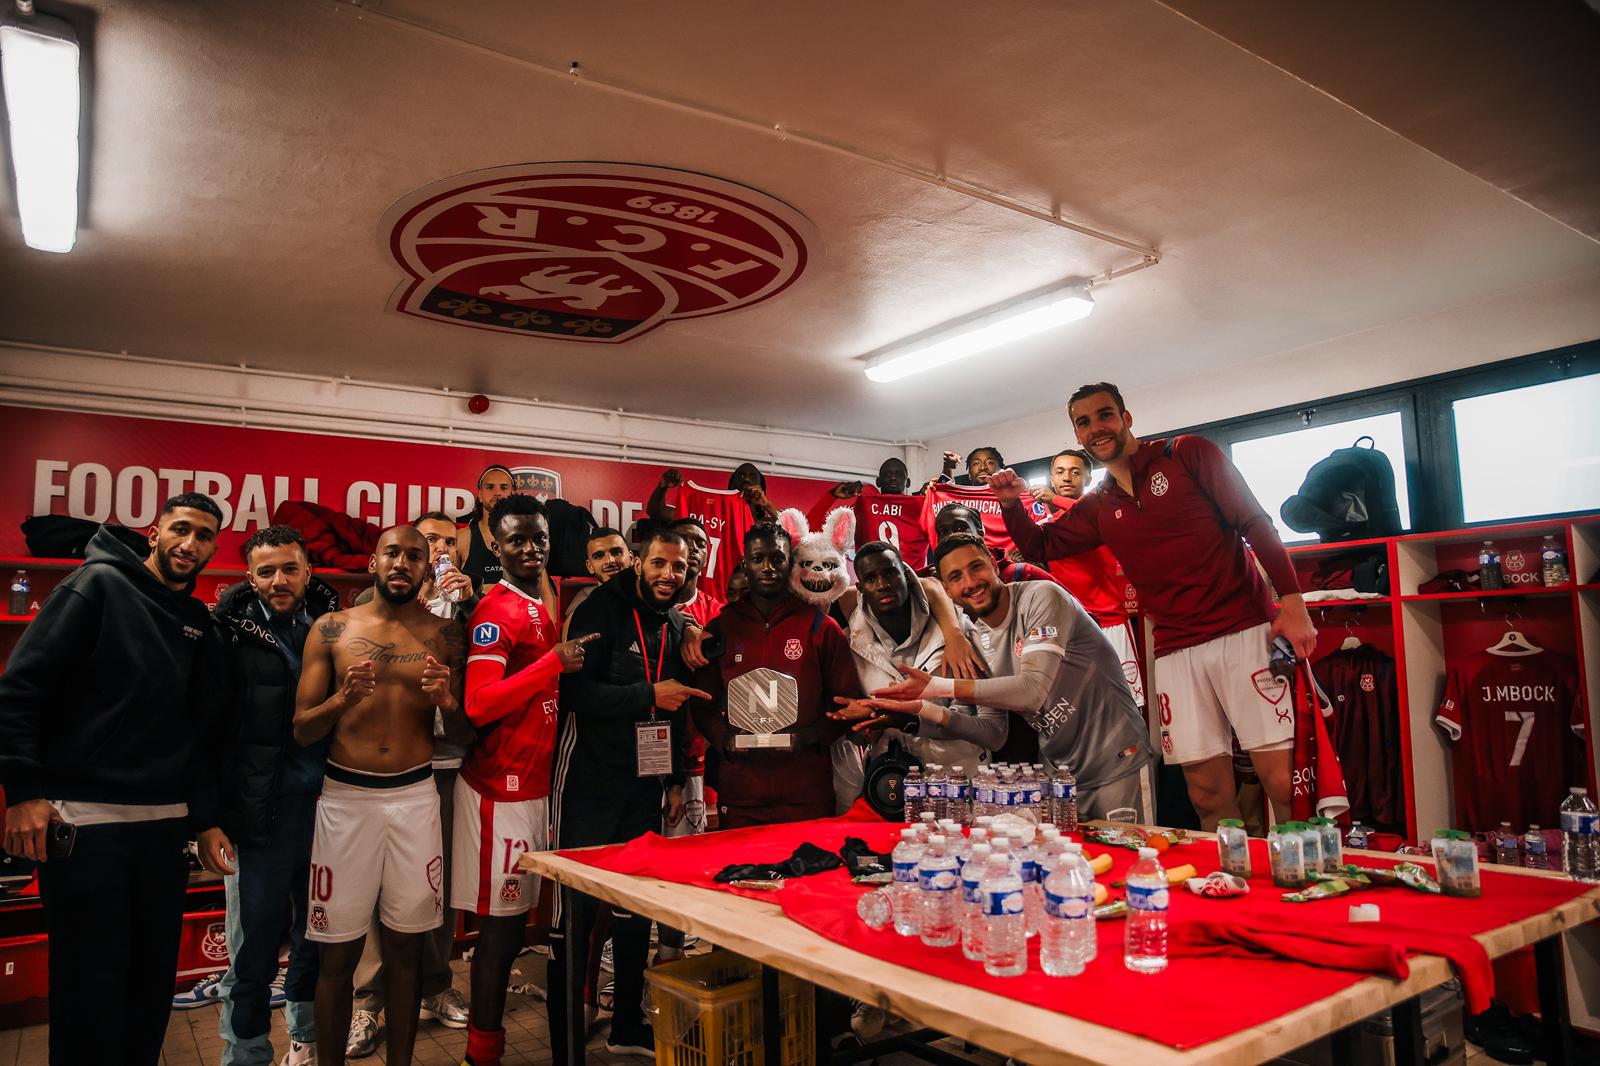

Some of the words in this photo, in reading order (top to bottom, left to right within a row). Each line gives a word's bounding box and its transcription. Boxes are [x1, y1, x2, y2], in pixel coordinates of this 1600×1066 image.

[626, 195, 721, 224] 1899
[871, 503, 902, 516] C.ABI
[480, 626, 492, 639] N
[749, 680, 778, 713] N
[1482, 685, 1555, 702] J.MBOCK
[1505, 711, 1535, 766] 7
[503, 838, 529, 876] 12
[310, 863, 333, 902] 10
